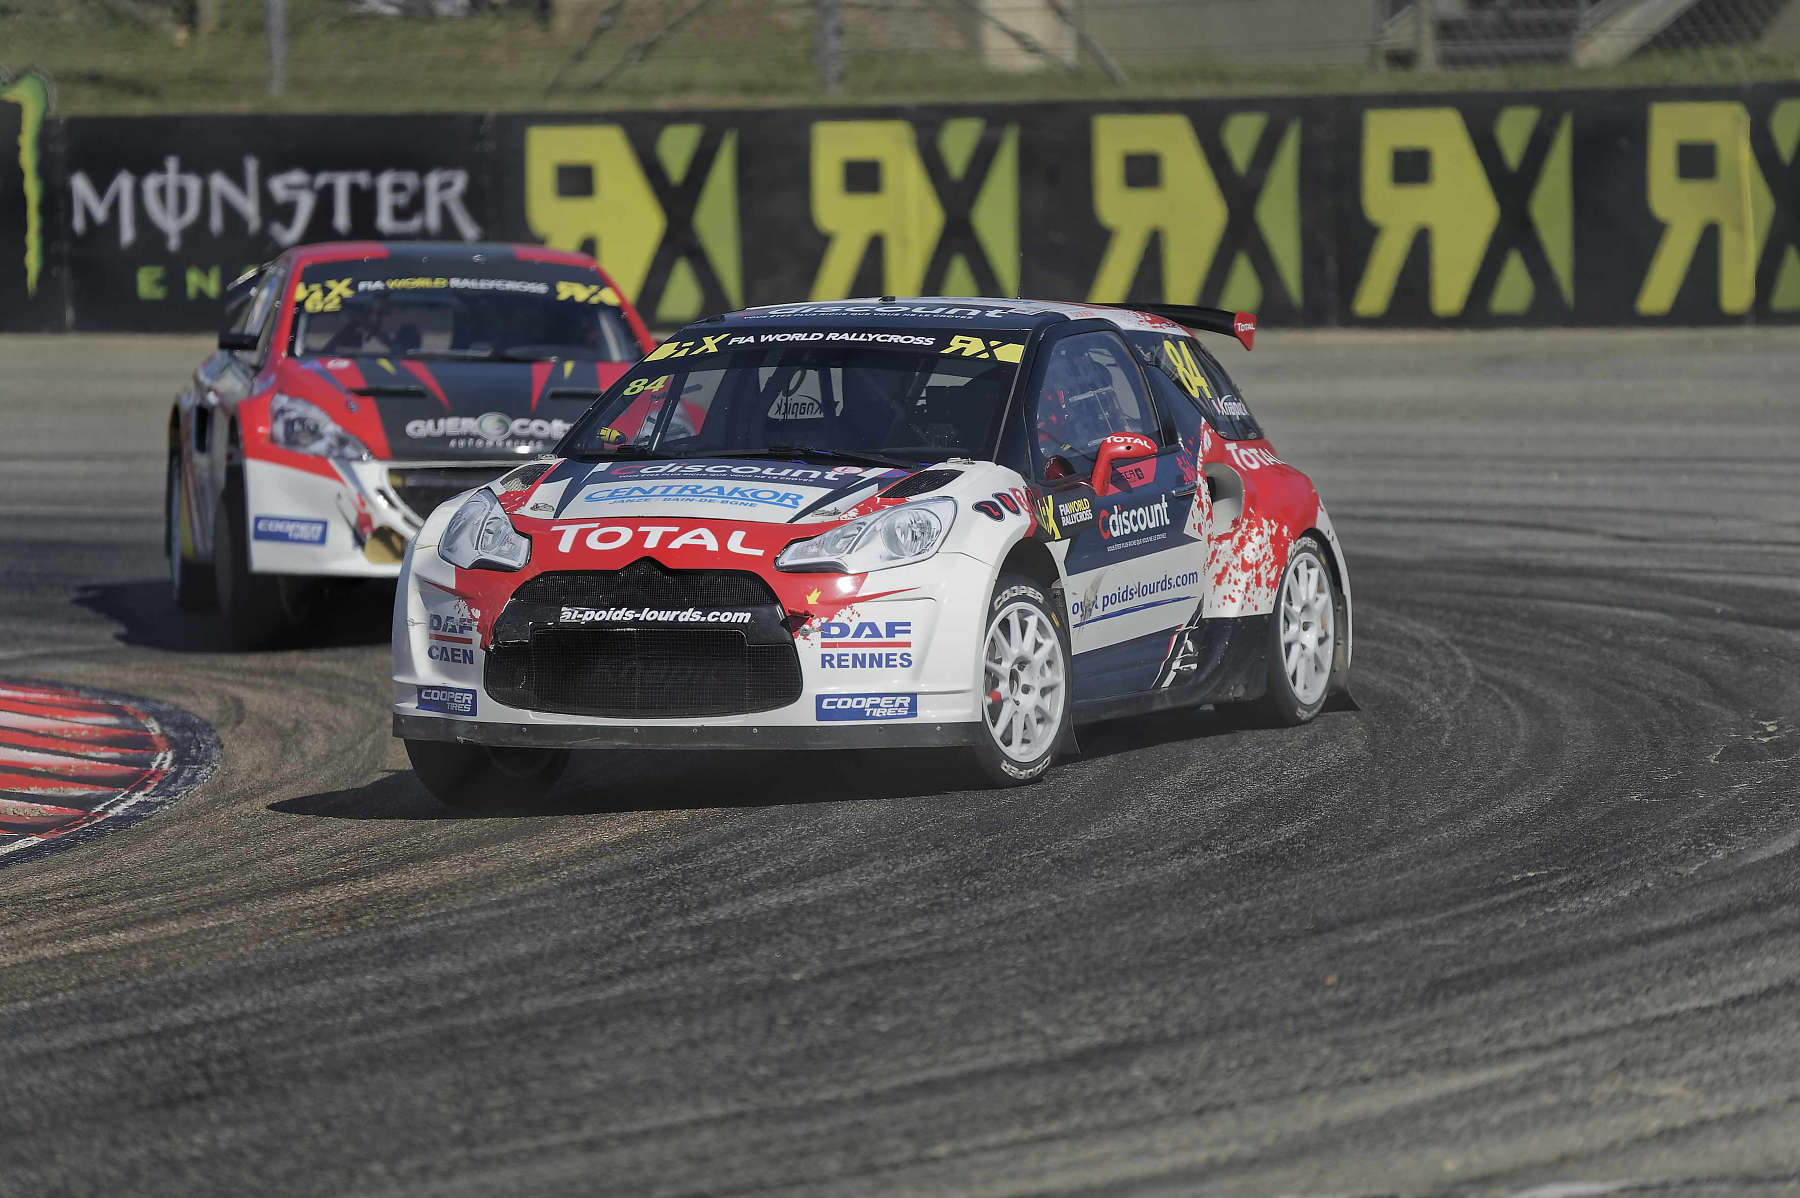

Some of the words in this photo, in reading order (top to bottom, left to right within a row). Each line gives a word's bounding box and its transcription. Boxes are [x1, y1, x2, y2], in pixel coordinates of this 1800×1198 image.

[70, 153, 482, 250] MONSTER
[1090, 112, 1302, 310] RX
[1353, 106, 1574, 317] RX
[1237, 322, 1255, 332] TOTAL
[728, 336, 755, 346] FIA
[760, 333, 824, 343] WORLD
[826, 333, 937, 346] RALLYCROSS
[1164, 340, 1212, 399] 84
[623, 376, 669, 396] 84
[1106, 436, 1151, 449] TOTAL
[1225, 443, 1288, 471] TOTAL
[610, 463, 843, 481] Cdiscount
[584, 484, 804, 507] CENTRAKOR
[1061, 509, 1093, 526] RALLYCROSS
[1098, 494, 1170, 540] Cdiscount
[550, 523, 765, 556] TOTAL
[994, 585, 1044, 611] COOPER
[1102, 571, 1198, 611] poids-lourds.com
[430, 614, 473, 634] DAF
[820, 622, 911, 638] DAF
[428, 645, 474, 664] CAEN
[820, 653, 912, 668] RENNES
[421, 689, 472, 704] COOPER
[821, 697, 910, 710] COOPER
[447, 702, 472, 712] TIRES
[863, 708, 909, 717] TIRES
